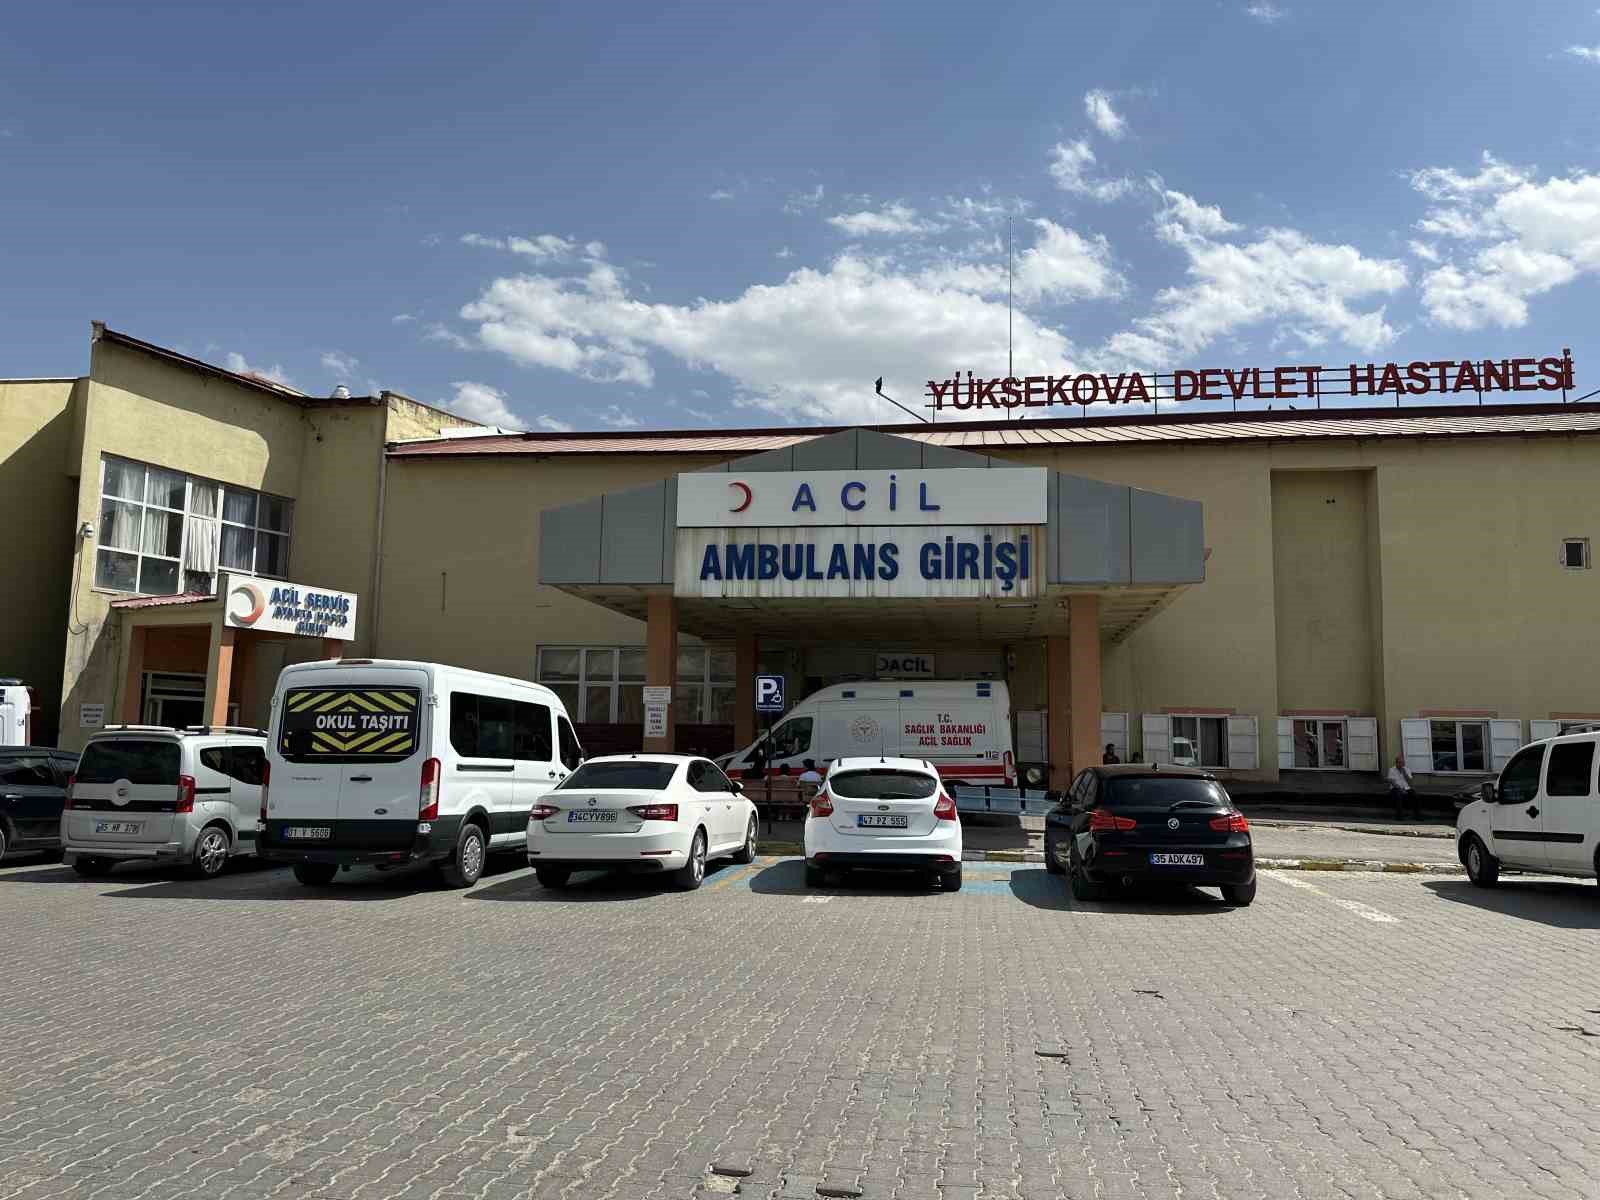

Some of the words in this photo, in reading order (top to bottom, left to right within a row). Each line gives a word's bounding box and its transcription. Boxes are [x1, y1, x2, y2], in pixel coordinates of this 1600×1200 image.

[928, 370, 1151, 410] YÜKSEKOVA
[1174, 366, 1322, 401] DEVLET
[1350, 348, 1573, 397] HASTANESİ
[791, 474, 941, 512] ACİL
[700, 543, 899, 581] AMBULANS
[919, 534, 1030, 591] GİRİŞİ
[269, 586, 301, 607] ACİL
[304, 592, 350, 613] SERVİS
[889, 656, 932, 673] ACİL
[758, 678, 778, 703] P
[315, 714, 357, 729] OKUL
[360, 714, 409, 733] TAŞITI
[937, 713, 953, 723] T.C.
[904, 723, 936, 735] SAĞLIK
[939, 723, 986, 735] BAKANLIĞI
[918, 735, 939, 747] ACİL
[940, 735, 972, 747] SAĞLIK
[1154, 854, 1167, 864] 35
